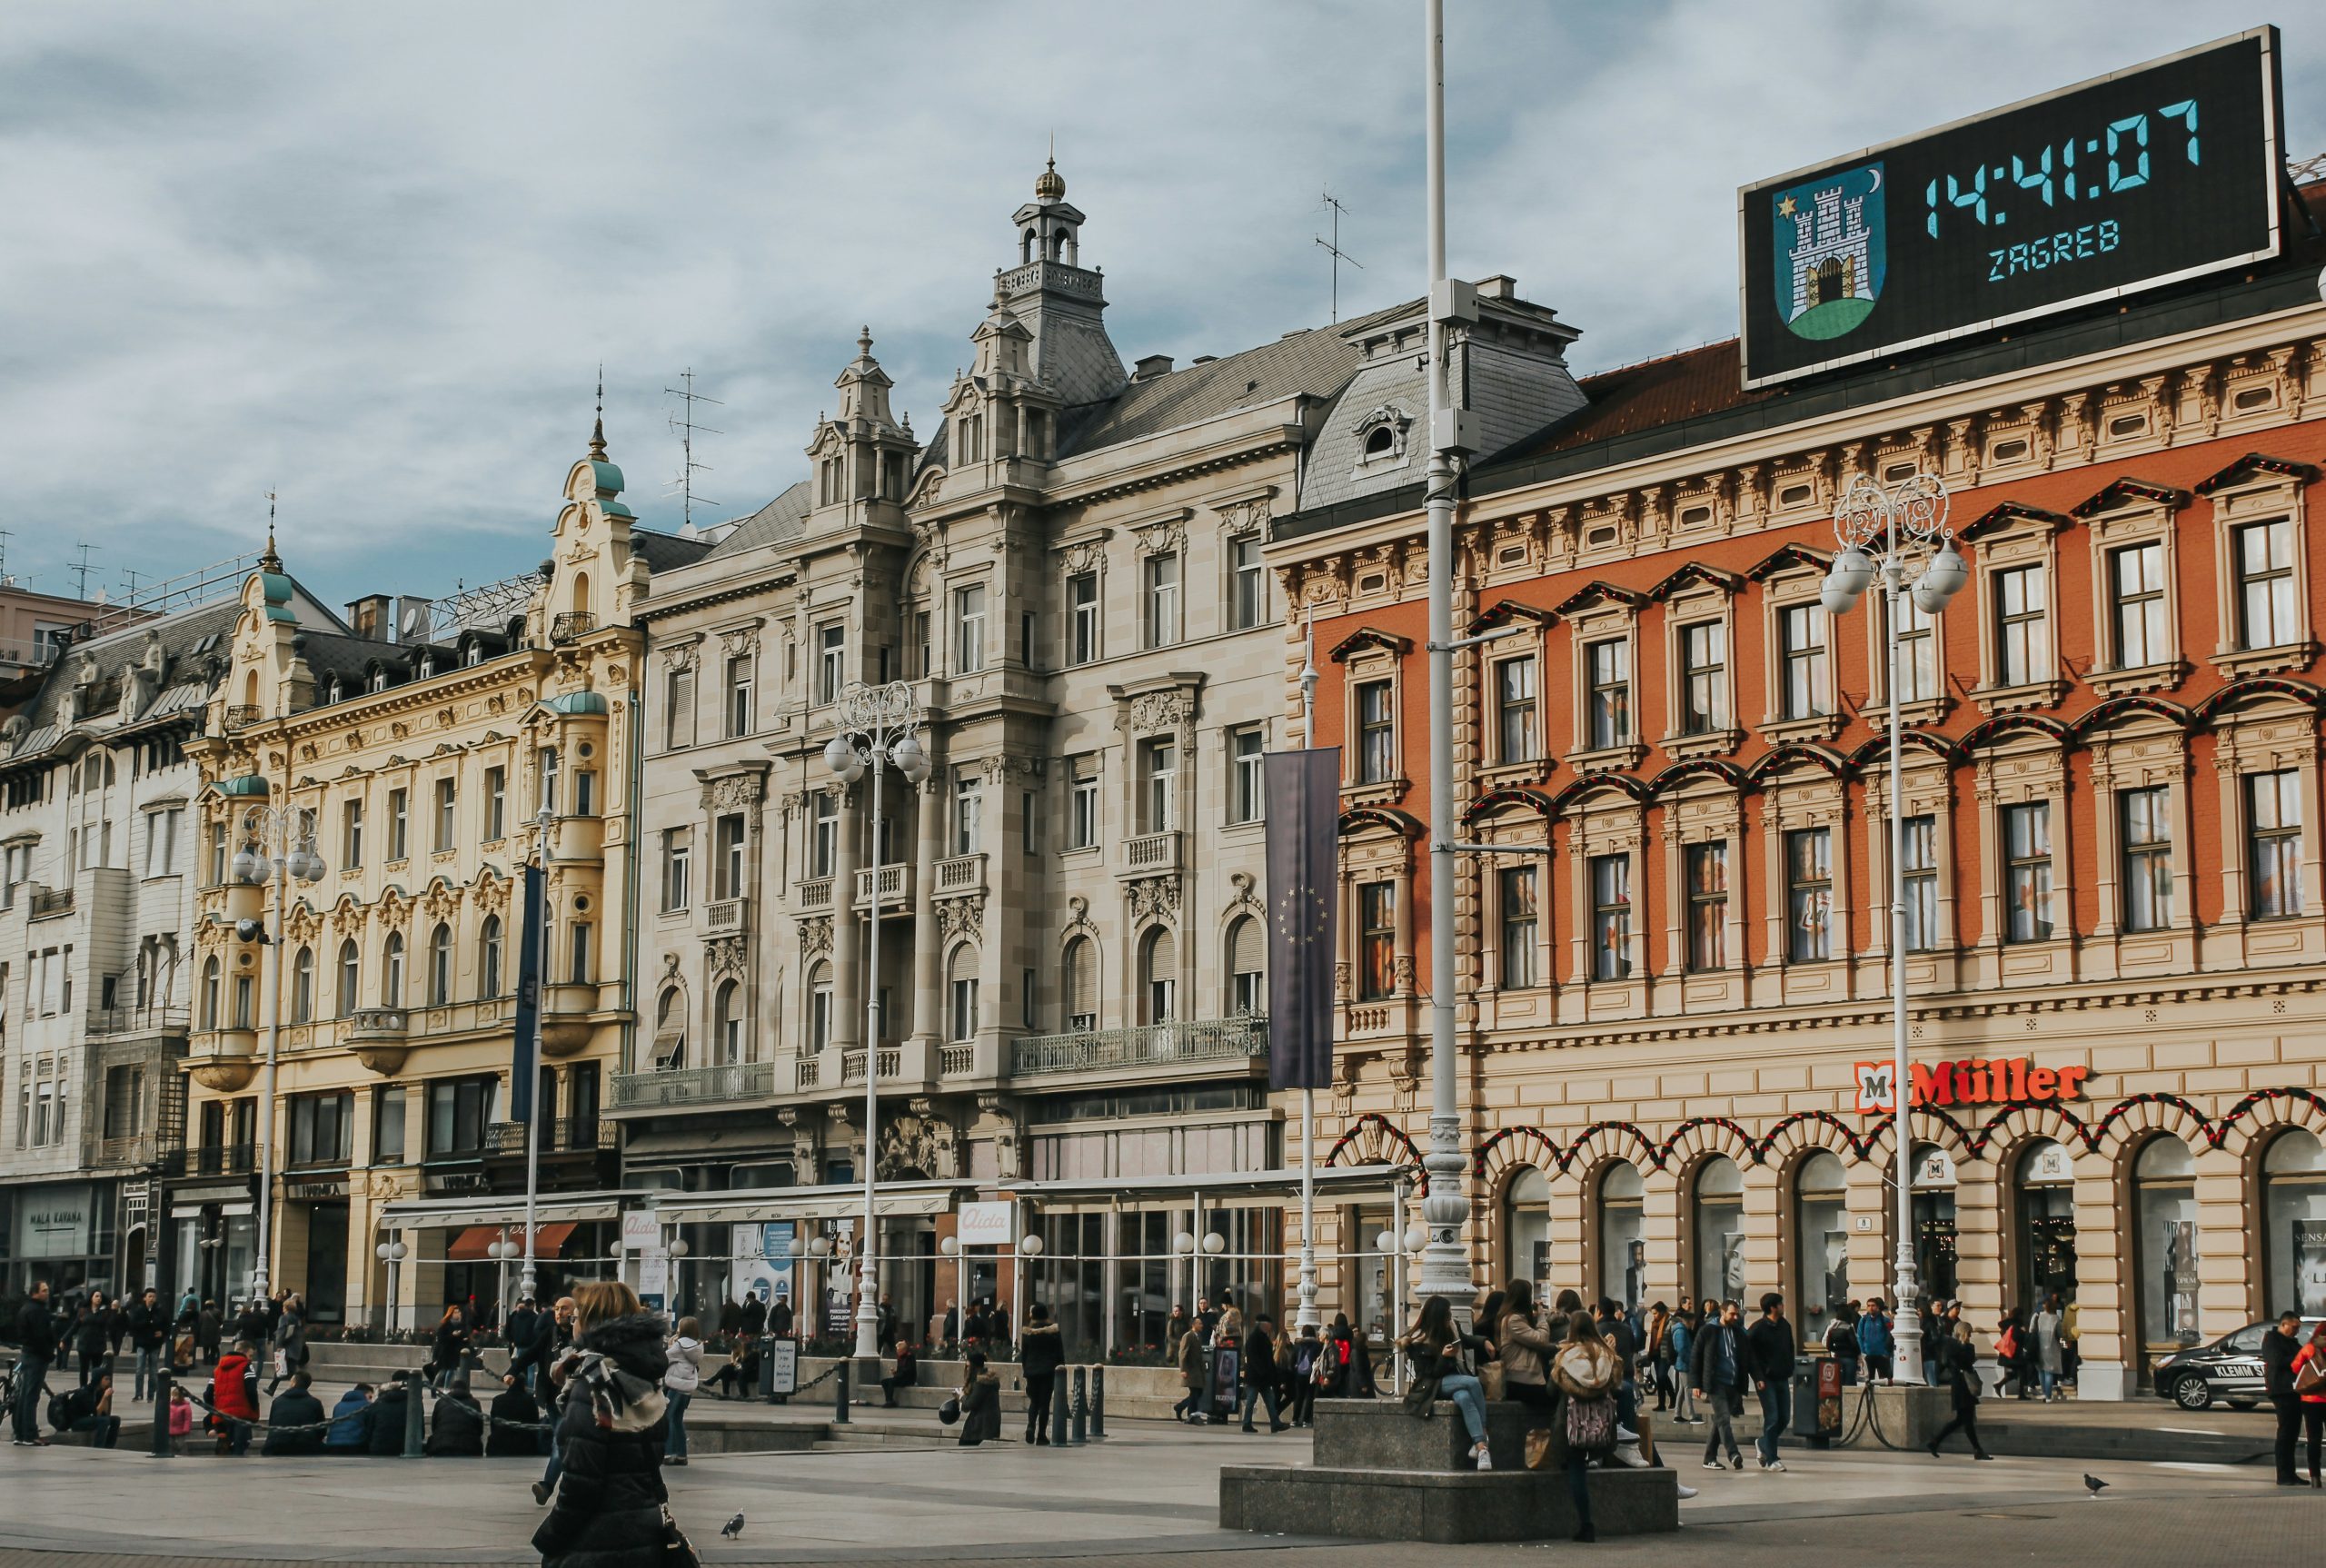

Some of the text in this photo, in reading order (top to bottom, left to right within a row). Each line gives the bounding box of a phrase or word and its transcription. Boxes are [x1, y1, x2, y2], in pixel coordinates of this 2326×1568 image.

[1926, 99, 2200, 240] 14:41:07
[1988, 220, 2120, 283] ZAGREB
[1864, 1057, 2088, 1107] M Müller
[30, 1211, 82, 1226] MALA KAVANA
[2214, 1365, 2254, 1377] KLEMM
